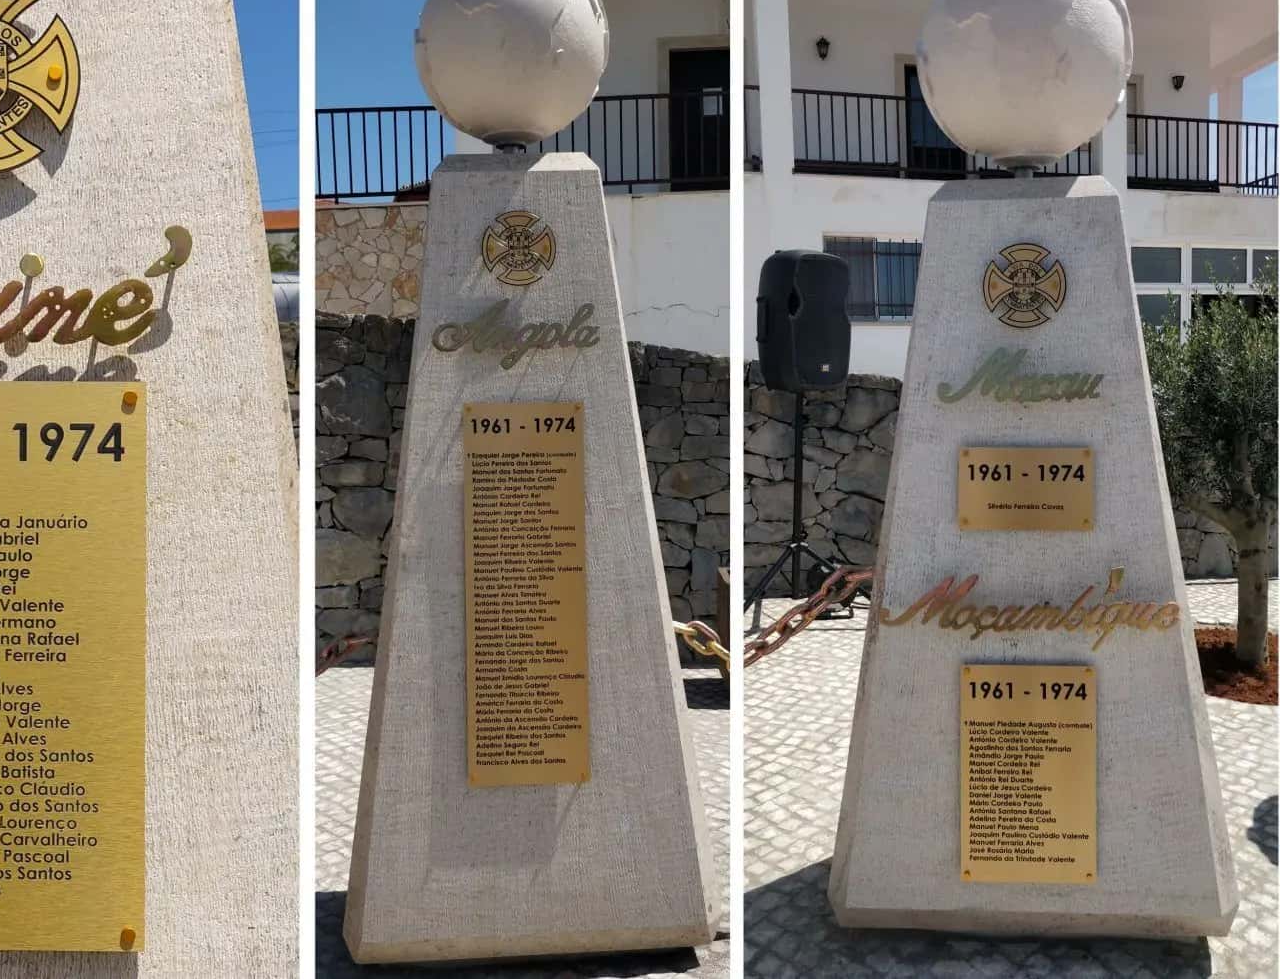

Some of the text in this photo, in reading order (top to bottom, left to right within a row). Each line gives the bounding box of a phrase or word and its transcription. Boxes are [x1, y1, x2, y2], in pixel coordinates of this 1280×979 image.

[432, 298, 600, 370] Angola
[471, 418, 511, 434] 1961
[534, 417, 576, 433] 1974
[12, 422, 125, 462] 1974
[968, 464, 1012, 482] 1961
[1038, 465, 1085, 482] 1974
[16, 515, 88, 529] Januário
[0, 598, 64, 611] Valente
[28, 632, 79, 645] Rafael
[5, 649, 66, 662] Ferreira
[969, 682, 1013, 699] 1961
[1040, 683, 1087, 700] 1974
[6, 715, 71, 728] Valente
[1, 732, 47, 745] Alves
[5, 749, 34, 762] dos
[40, 749, 94, 762] Santos
[1, 766, 55, 779] Batista
[20, 782, 85, 796] Cláudio
[10, 799, 39, 812] dos
[45, 800, 99, 813] Santos
[0, 816, 77, 832] Lourenço
[0, 833, 97, 846] Carvalheiro
[4, 850, 69, 863] Pascoal
[17, 867, 72, 880] Santos
